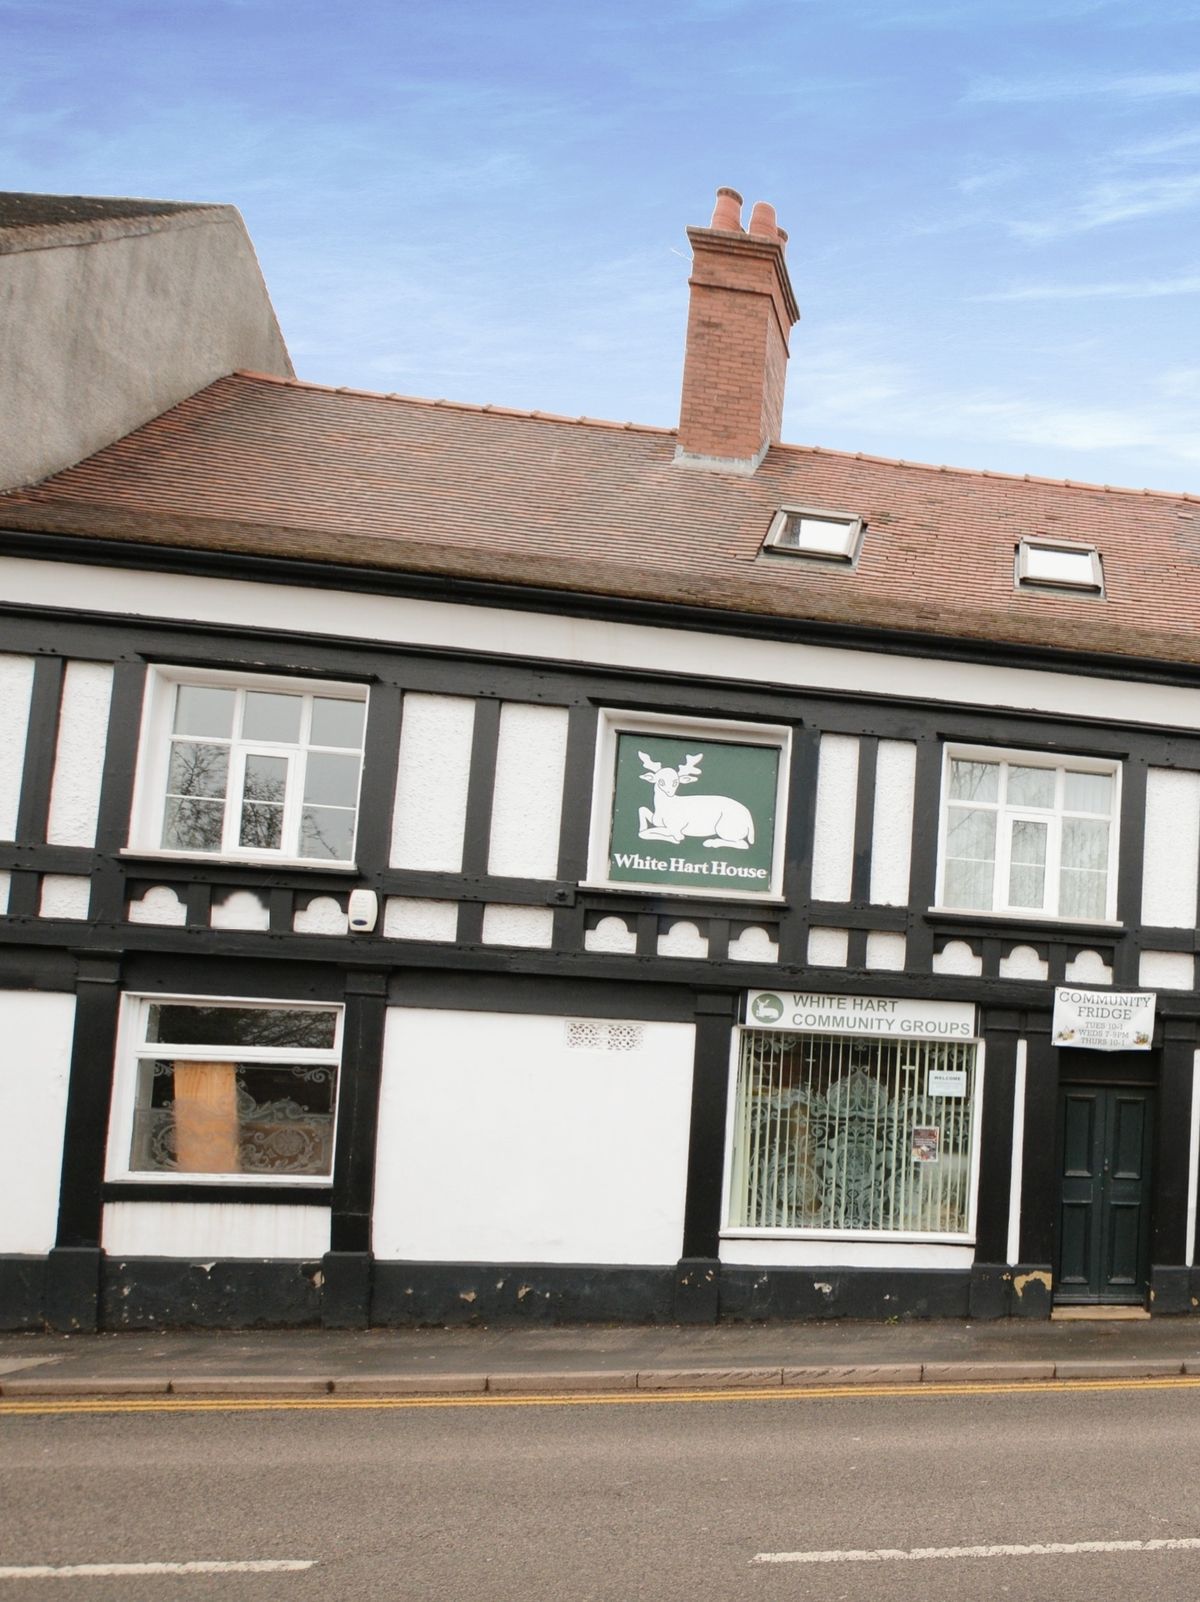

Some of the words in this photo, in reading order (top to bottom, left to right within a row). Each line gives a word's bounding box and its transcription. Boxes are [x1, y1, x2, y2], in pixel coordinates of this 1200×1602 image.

[614, 853, 668, 870] White
[669, 858, 709, 875] Hart
[711, 861, 769, 879] House
[793, 994, 847, 1011] WHITE
[852, 997, 899, 1013] HART
[1060, 991, 1152, 1008] COMMUNITY
[1077, 1006, 1132, 1020] FRIDGE
[792, 1013, 896, 1031] COMMUNITY
[900, 1019, 970, 1035] GROUPS
[1085, 1021, 1106, 1030] TUES
[1079, 1029, 1103, 1037] WEDS
[1081, 1037, 1107, 1045] THURS
